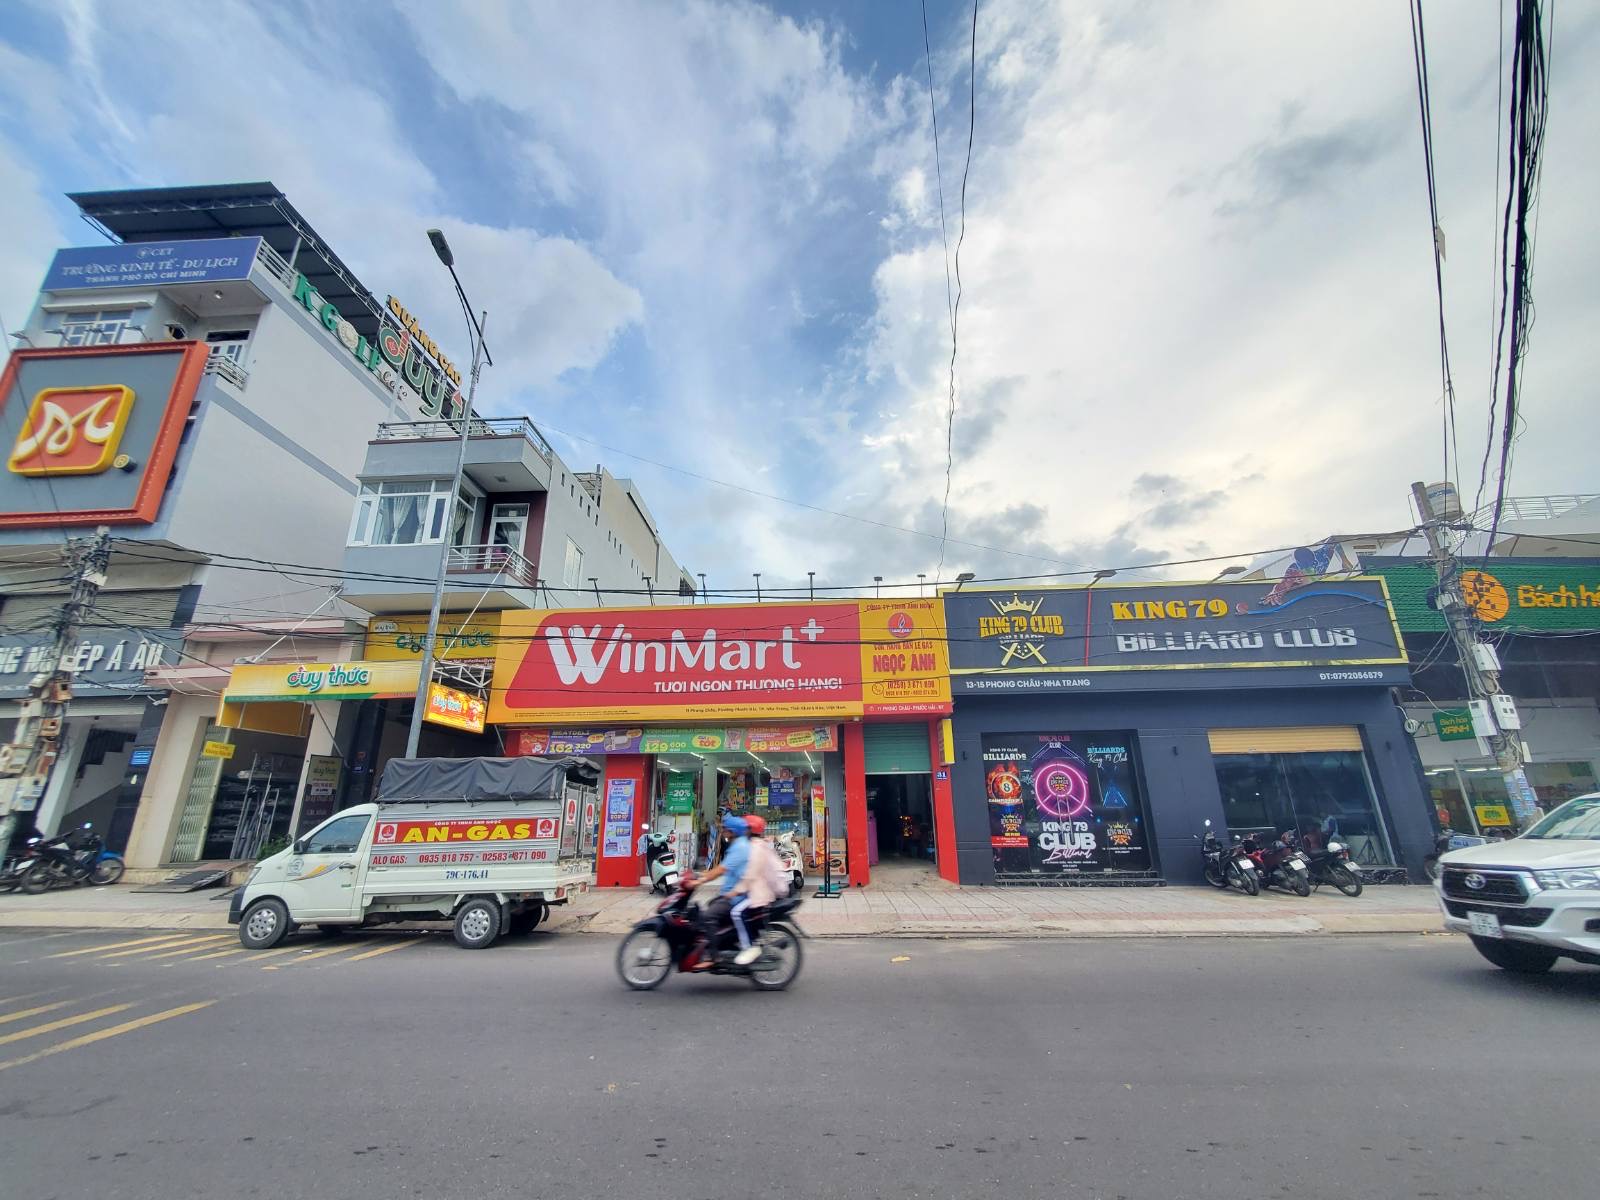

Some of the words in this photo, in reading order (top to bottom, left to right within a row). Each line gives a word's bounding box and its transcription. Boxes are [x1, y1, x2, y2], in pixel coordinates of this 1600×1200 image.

[119, 261, 154, 272] KINH
[183, 259, 203, 268] DU
[978, 615, 1011, 638] KING
[1012, 615, 1028, 633] 79
[1030, 615, 1065, 636] CLUB
[1116, 630, 1264, 652] BILLIARD
[1274, 628, 1358, 648] CLUB
[104, 639, 128, 671] Á
[873, 654, 906, 675] NGỌC
[911, 653, 936, 671] ANH
[690, 680, 732, 692] NGON
[966, 681, 985, 689] 13-15
[985, 680, 1016, 689] PHONG
[1062, 678, 1091, 687] TRANG
[983, 753, 1027, 761] BILLIARDS
[1042, 821, 1071, 832] KING
[1073, 821, 1088, 832] 79
[1039, 832, 1097, 850] CLUB
[372, 855, 388, 865] ALO
[389, 855, 408, 864] GAS:
[419, 854, 439, 864] 0935
[441, 853, 456, 863] 818
[459, 853, 474, 863] 757
[482, 852, 507, 862] 02583
[531, 850, 547, 860] 090
